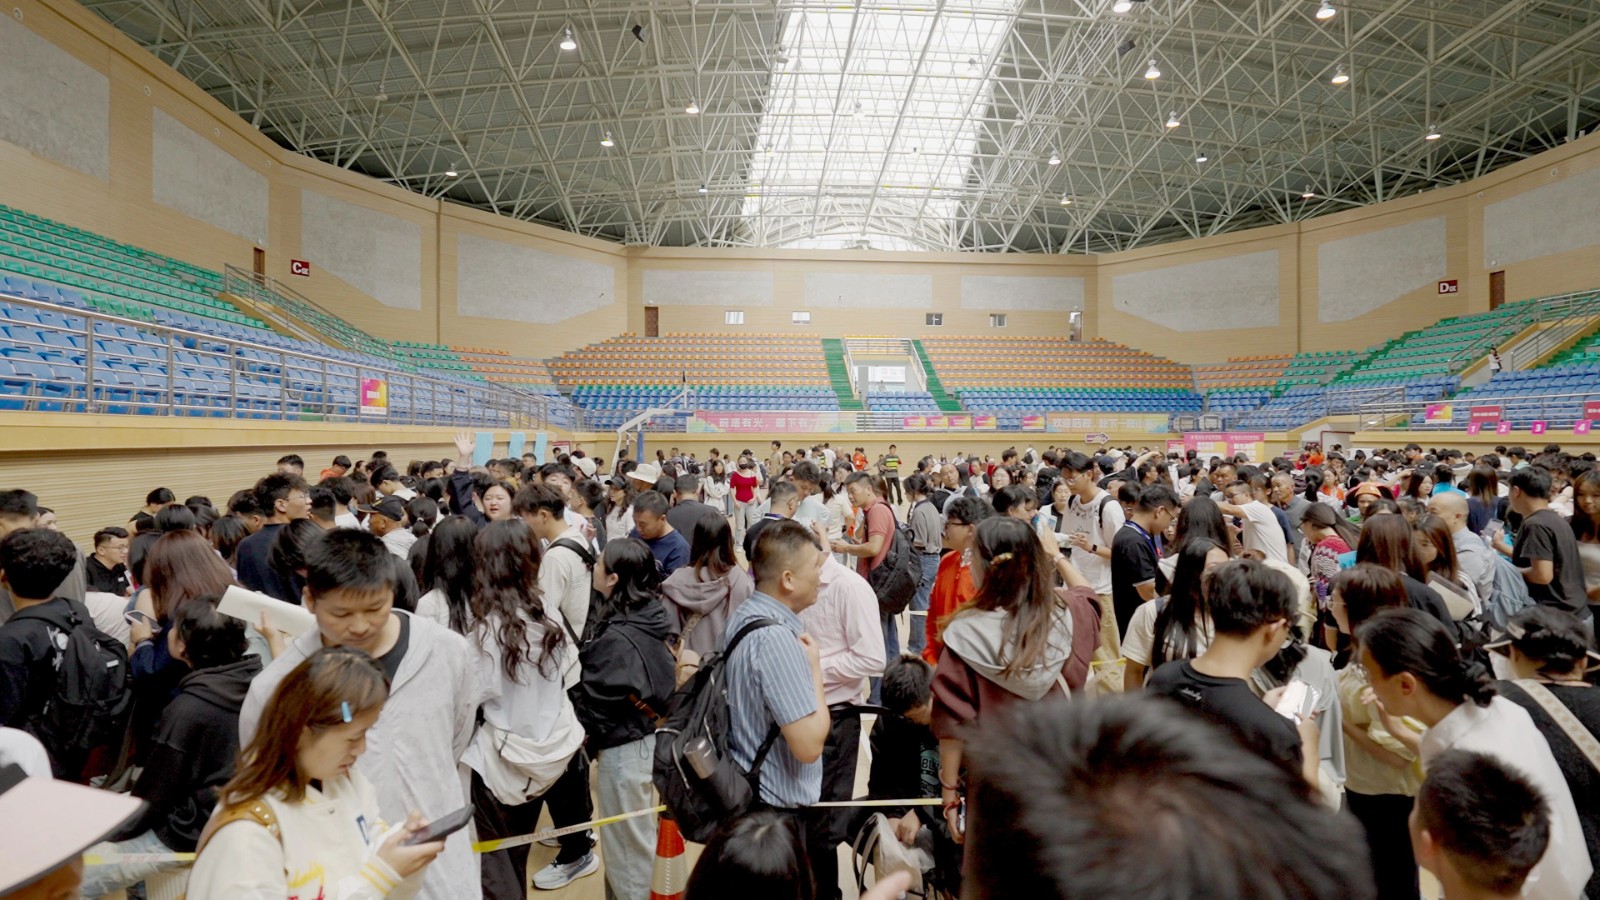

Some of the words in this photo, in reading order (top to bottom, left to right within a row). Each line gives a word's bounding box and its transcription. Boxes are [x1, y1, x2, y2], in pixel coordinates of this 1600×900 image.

[1470, 425, 1476, 433] 1
[1500, 424, 1507, 432] 2
[1535, 424, 1541, 432] 3
